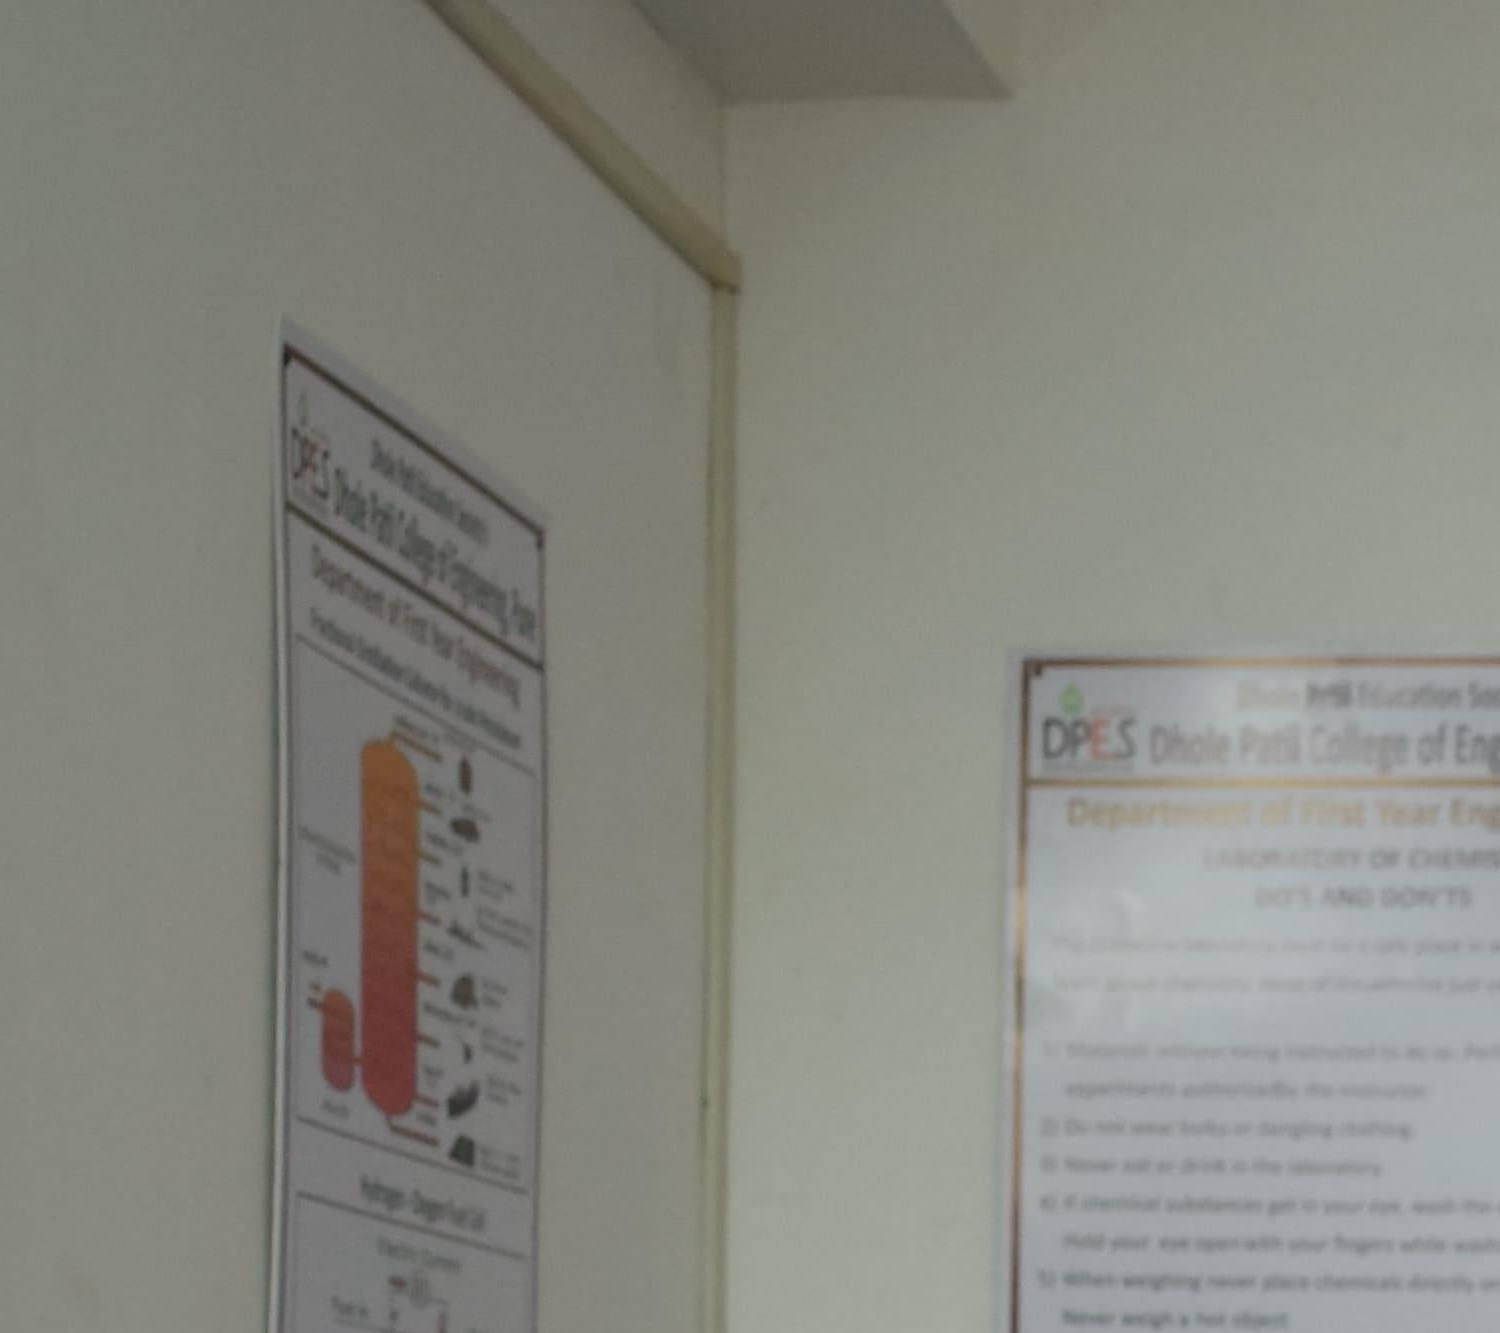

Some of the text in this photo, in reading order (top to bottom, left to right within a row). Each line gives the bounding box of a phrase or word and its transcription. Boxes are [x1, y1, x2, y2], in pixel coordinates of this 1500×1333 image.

[1043, 715, 1138, 761] DPES
[1416, 721, 1447, 764] of
[1374, 798, 1444, 829] Year
[1369, 847, 1401, 871] OF
[1319, 885, 1375, 909] AND
